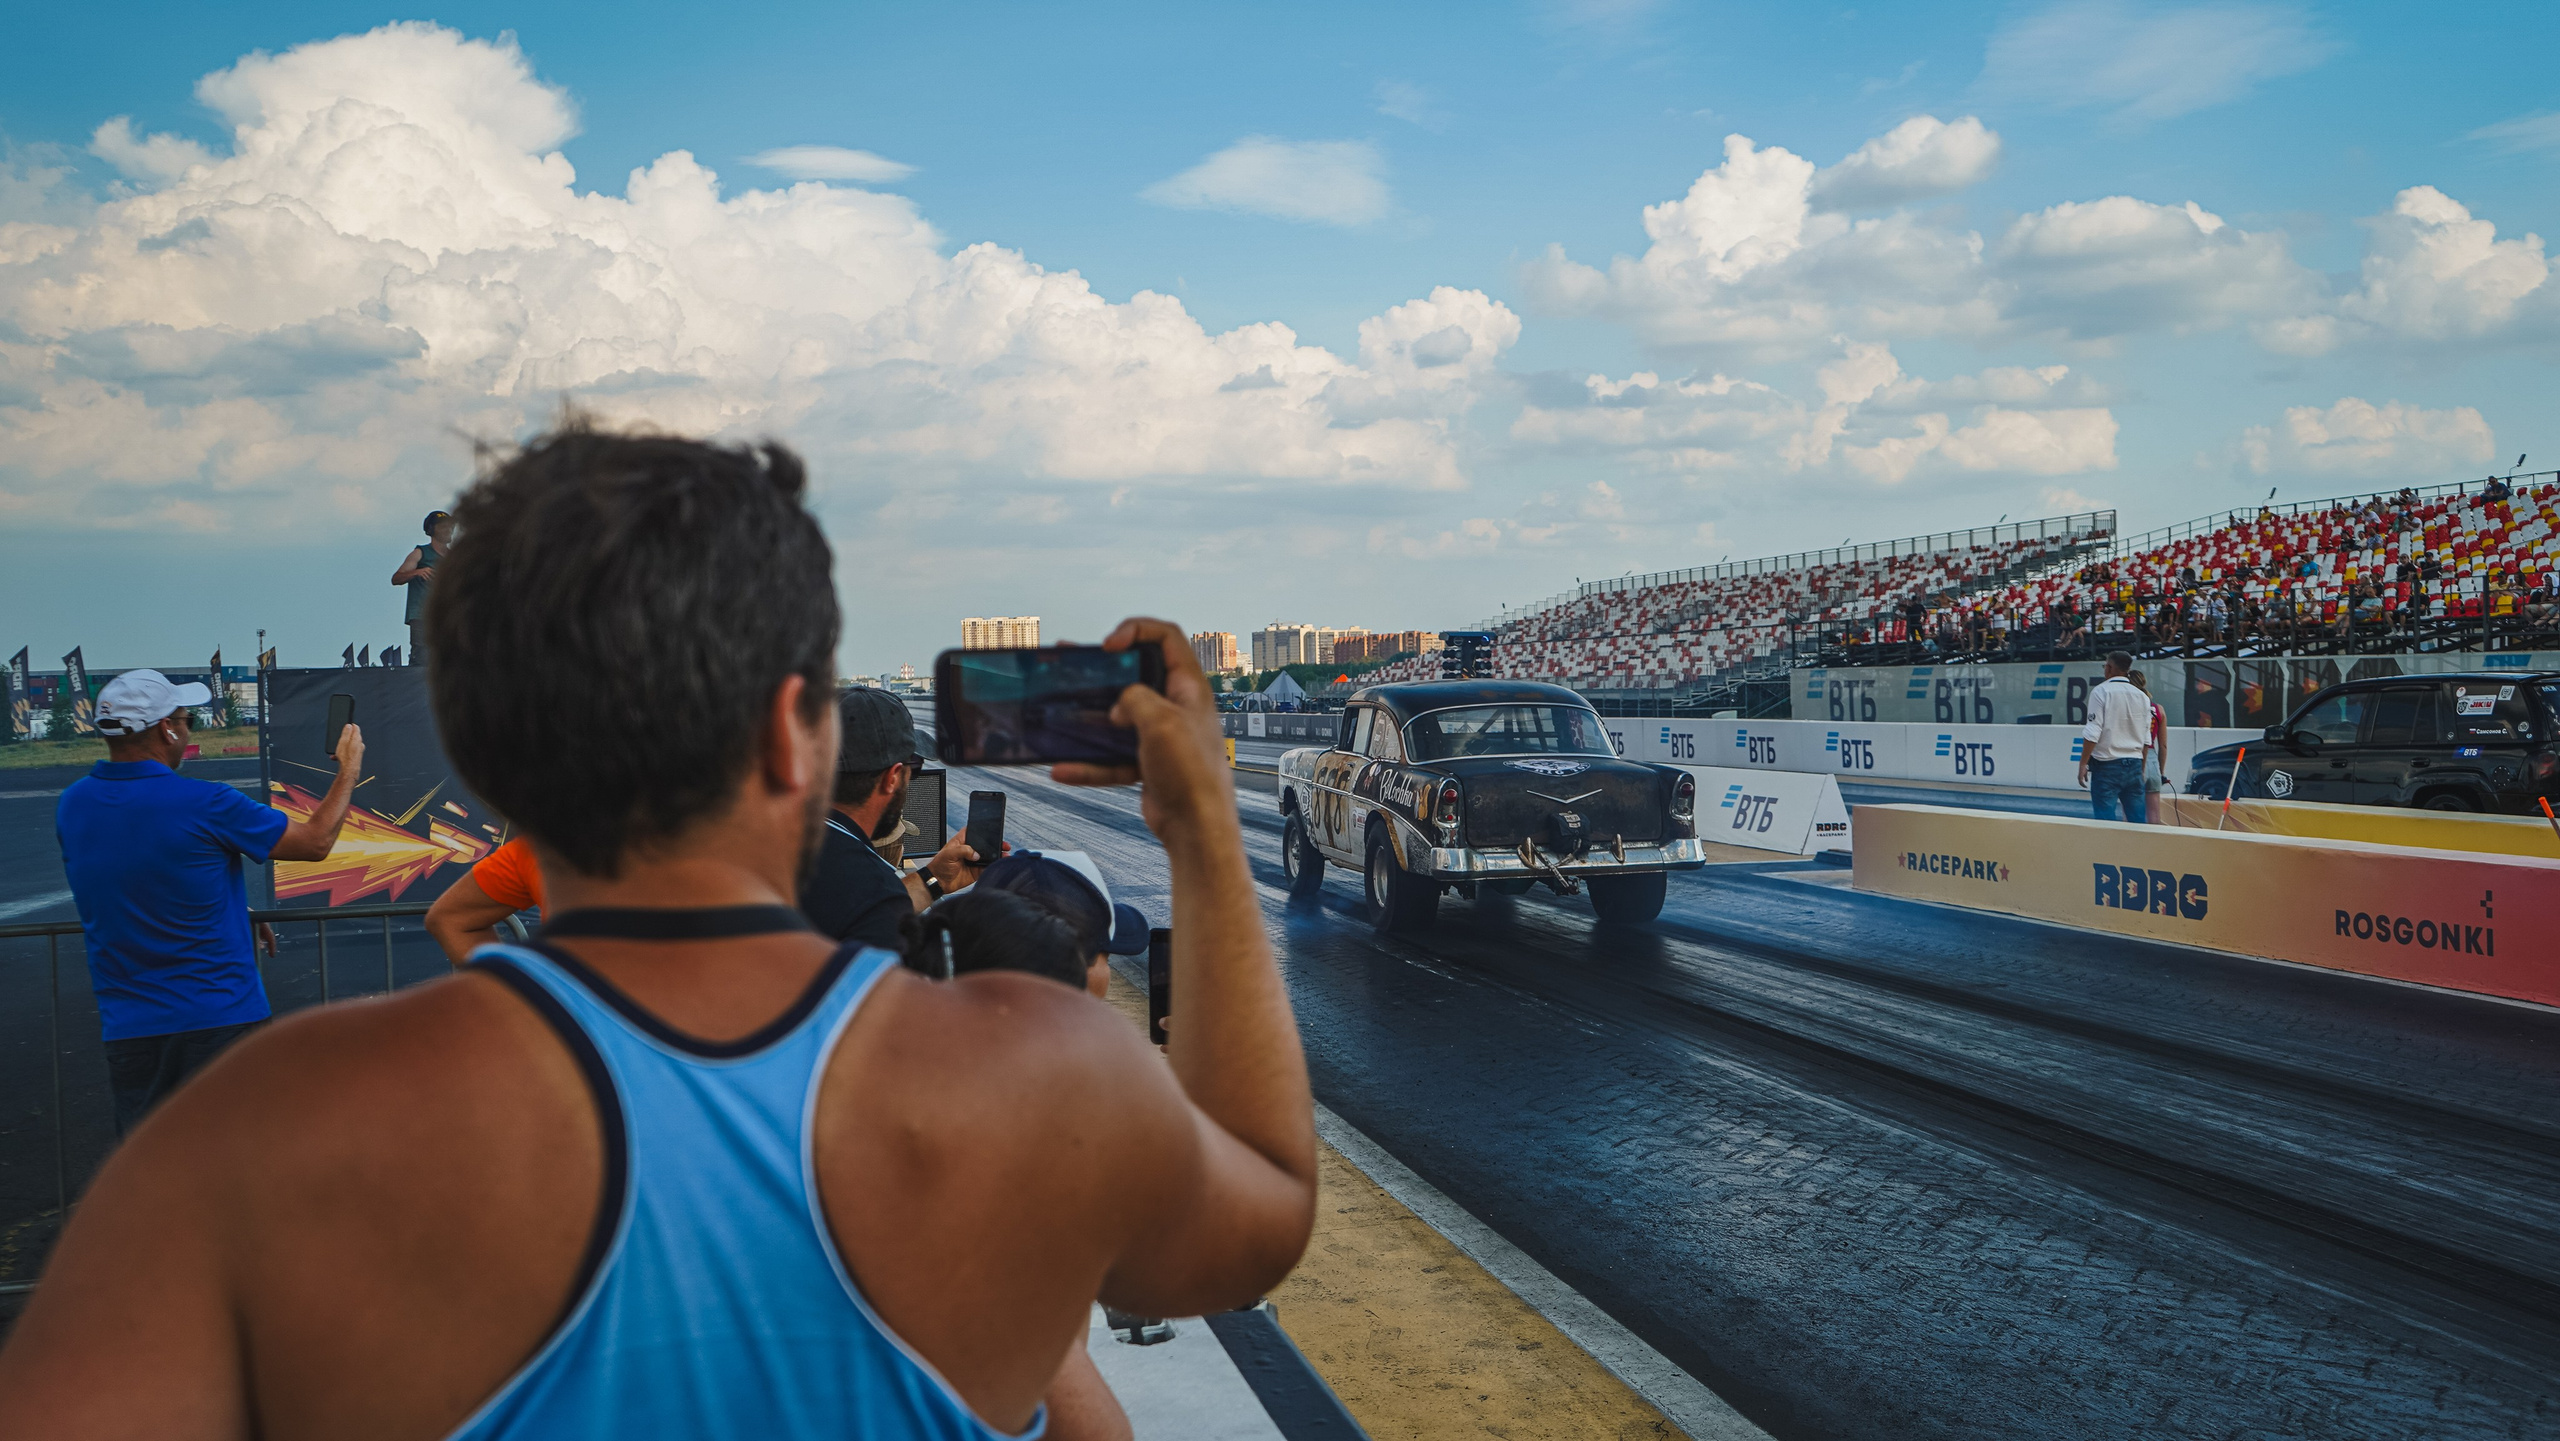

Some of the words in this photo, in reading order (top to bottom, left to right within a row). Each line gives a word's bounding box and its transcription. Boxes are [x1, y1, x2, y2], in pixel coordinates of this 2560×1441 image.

[1829, 679, 1877, 721] ВТБ
[1934, 677, 1994, 723] ВТБ
[1609, 732, 1625, 755] ТБ
[1671, 733, 1695, 759] ВТБ
[1749, 736, 1776, 764] ВТБ
[1841, 739, 1874, 770] ВТБ
[2463, 748, 2478, 756] ВТБ
[1954, 742, 1995, 777] ВТБ
[1731, 794, 1779, 833] ВТБ
[1815, 822, 1847, 831] RDRC
[1907, 852, 1999, 883] RACEPARK
[2093, 862, 2208, 921] RDRC
[2335, 909, 2494, 957] ROSGONKI
